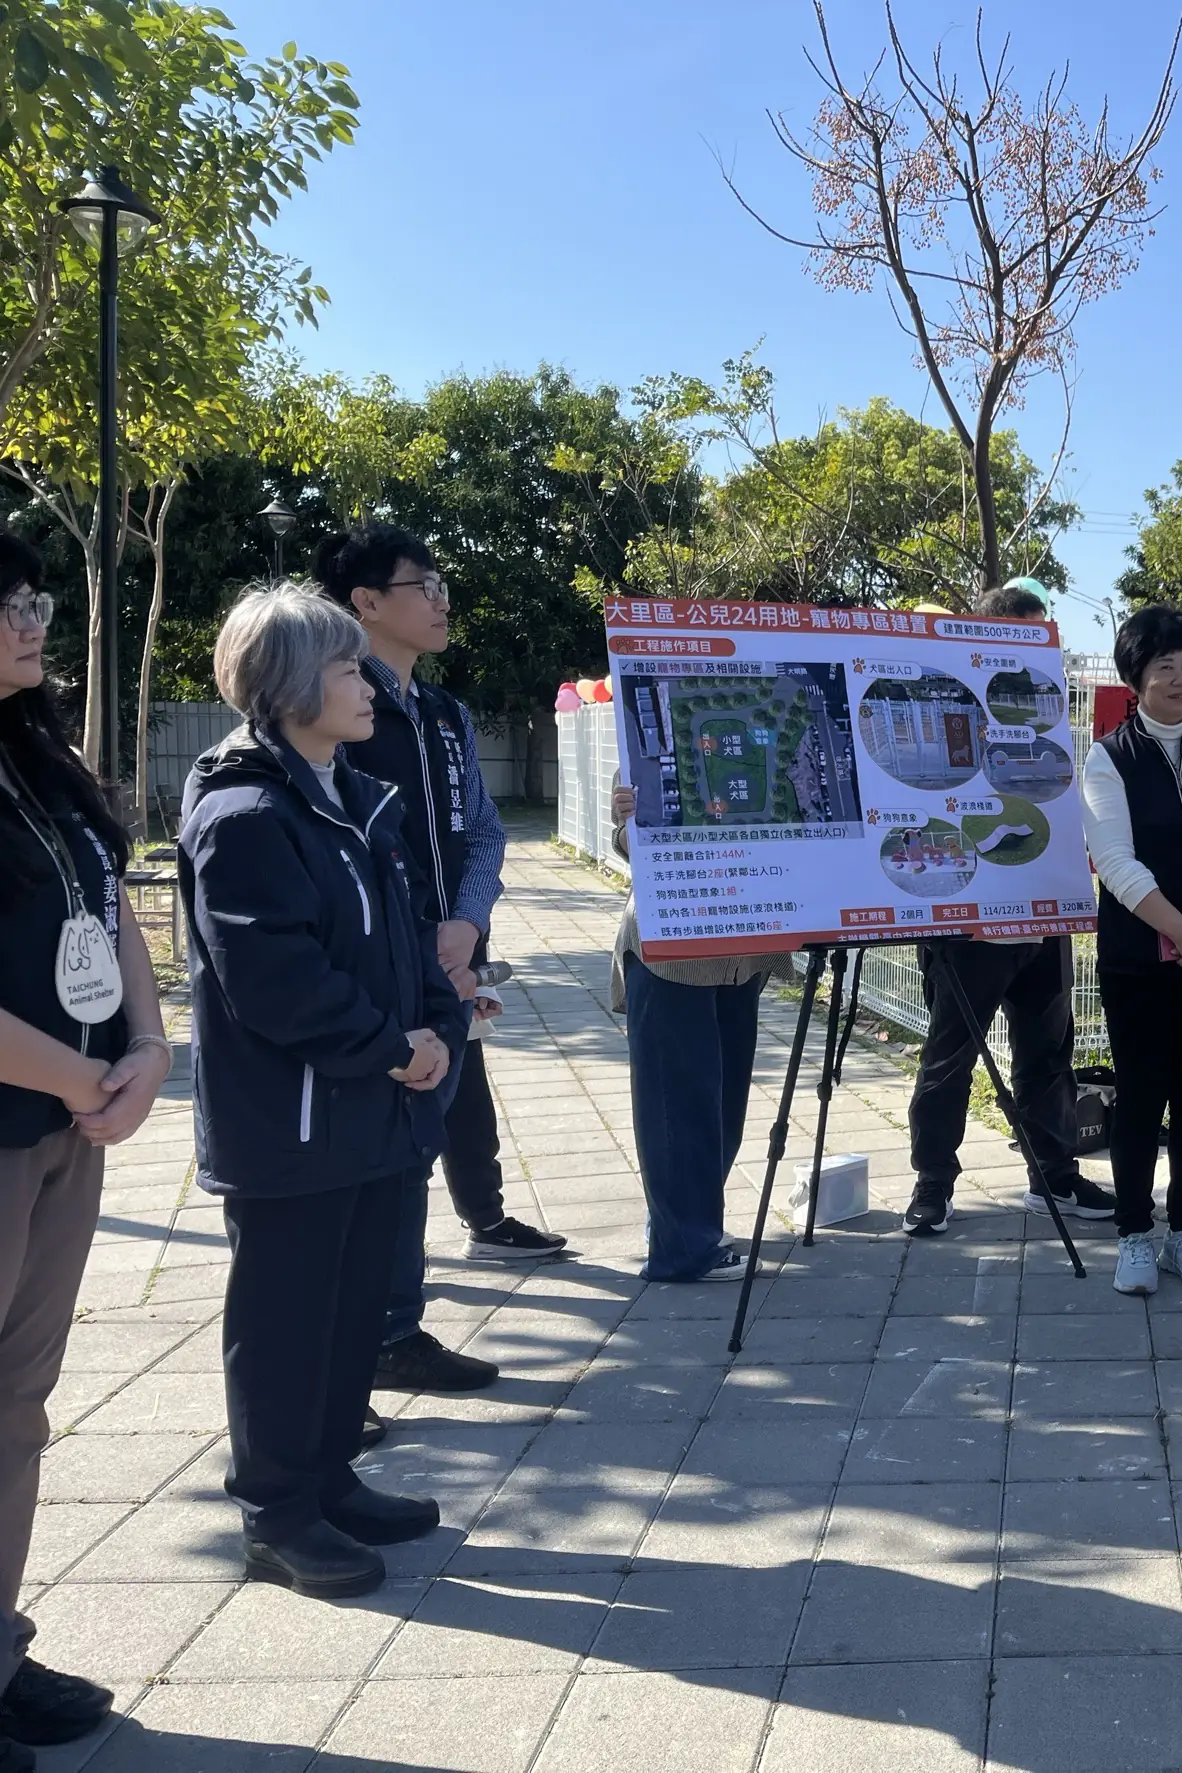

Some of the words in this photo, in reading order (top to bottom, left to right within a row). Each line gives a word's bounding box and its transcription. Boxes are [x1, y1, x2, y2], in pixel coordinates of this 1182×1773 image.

[606, 601, 929, 634] 大里區-公兒24用地-寵物專區建置
[944, 622, 1041, 641] 建置範圍500平方公尺
[633, 640, 711, 653] 工程施作項目
[633, 662, 762, 675] 增設寵物專區及相關設施
[870, 665, 912, 676] 犬區出入口
[883, 812, 917, 824] 狗狗意象
[942, 907, 968, 918] 完工日
[983, 904, 1025, 917] 114/12/31
[1061, 901, 1093, 912] 320萬元
[67, 978, 104, 994] TAICHUNG
[69, 990, 93, 1006] Animal
[94, 987, 115, 1002] Shelter
